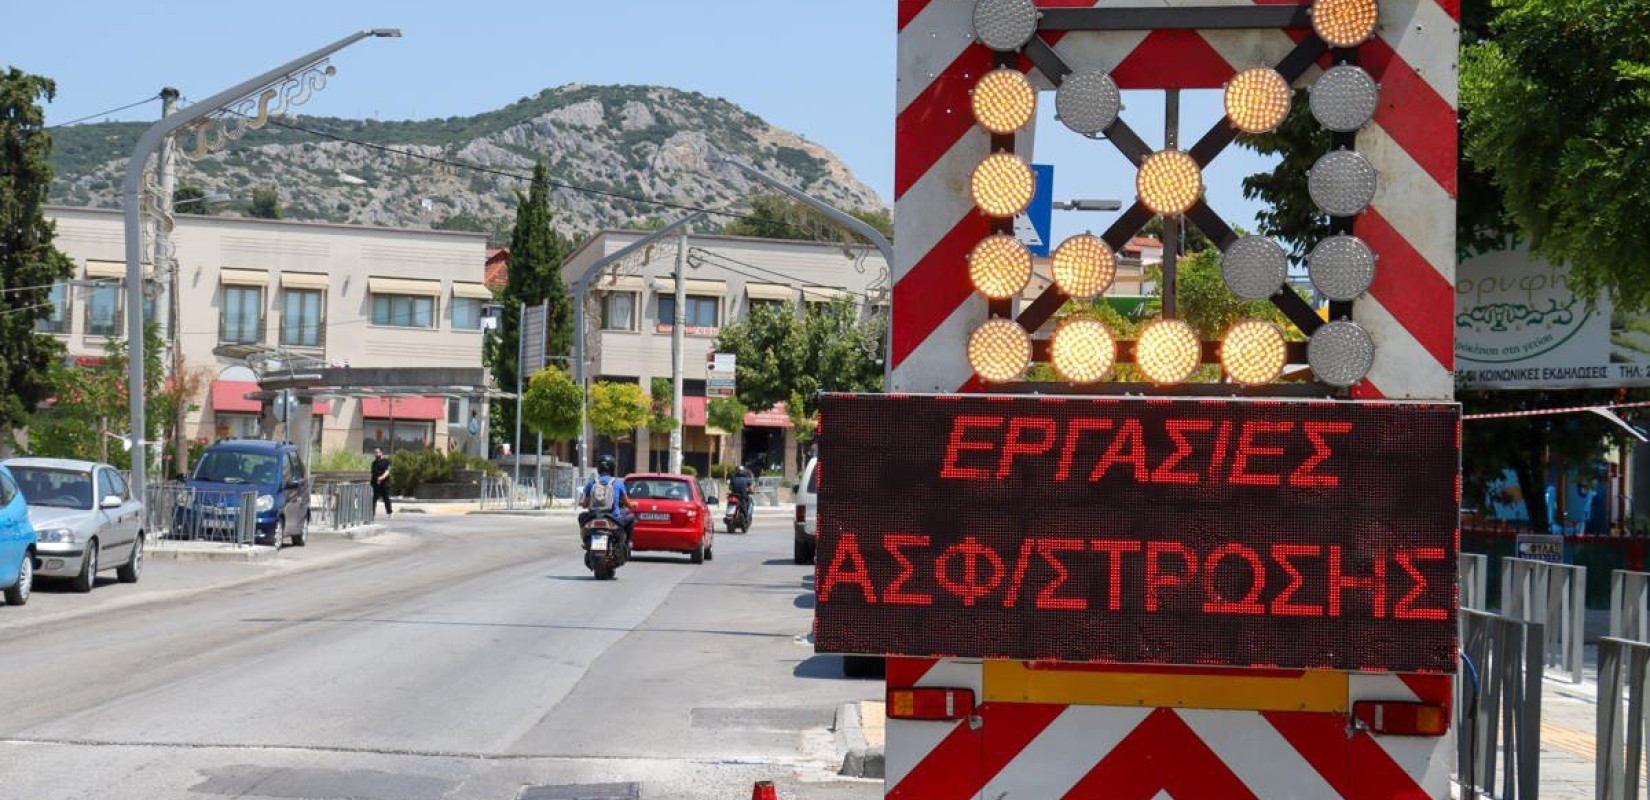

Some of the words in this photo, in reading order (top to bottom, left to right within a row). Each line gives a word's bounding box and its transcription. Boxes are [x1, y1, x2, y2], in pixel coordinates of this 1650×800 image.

[1479, 369, 1541, 382] ΚΟΙΝΩΝΙΚΕΣ
[1543, 366, 1608, 381] ΕΚΔΗΛΩΣΕΙΣ
[940, 415, 1353, 488] ΕΡΓΑΣΙΕΣ
[817, 532, 1449, 621] ΑΣΦ/ΣΤΡΩΣΗΣ
